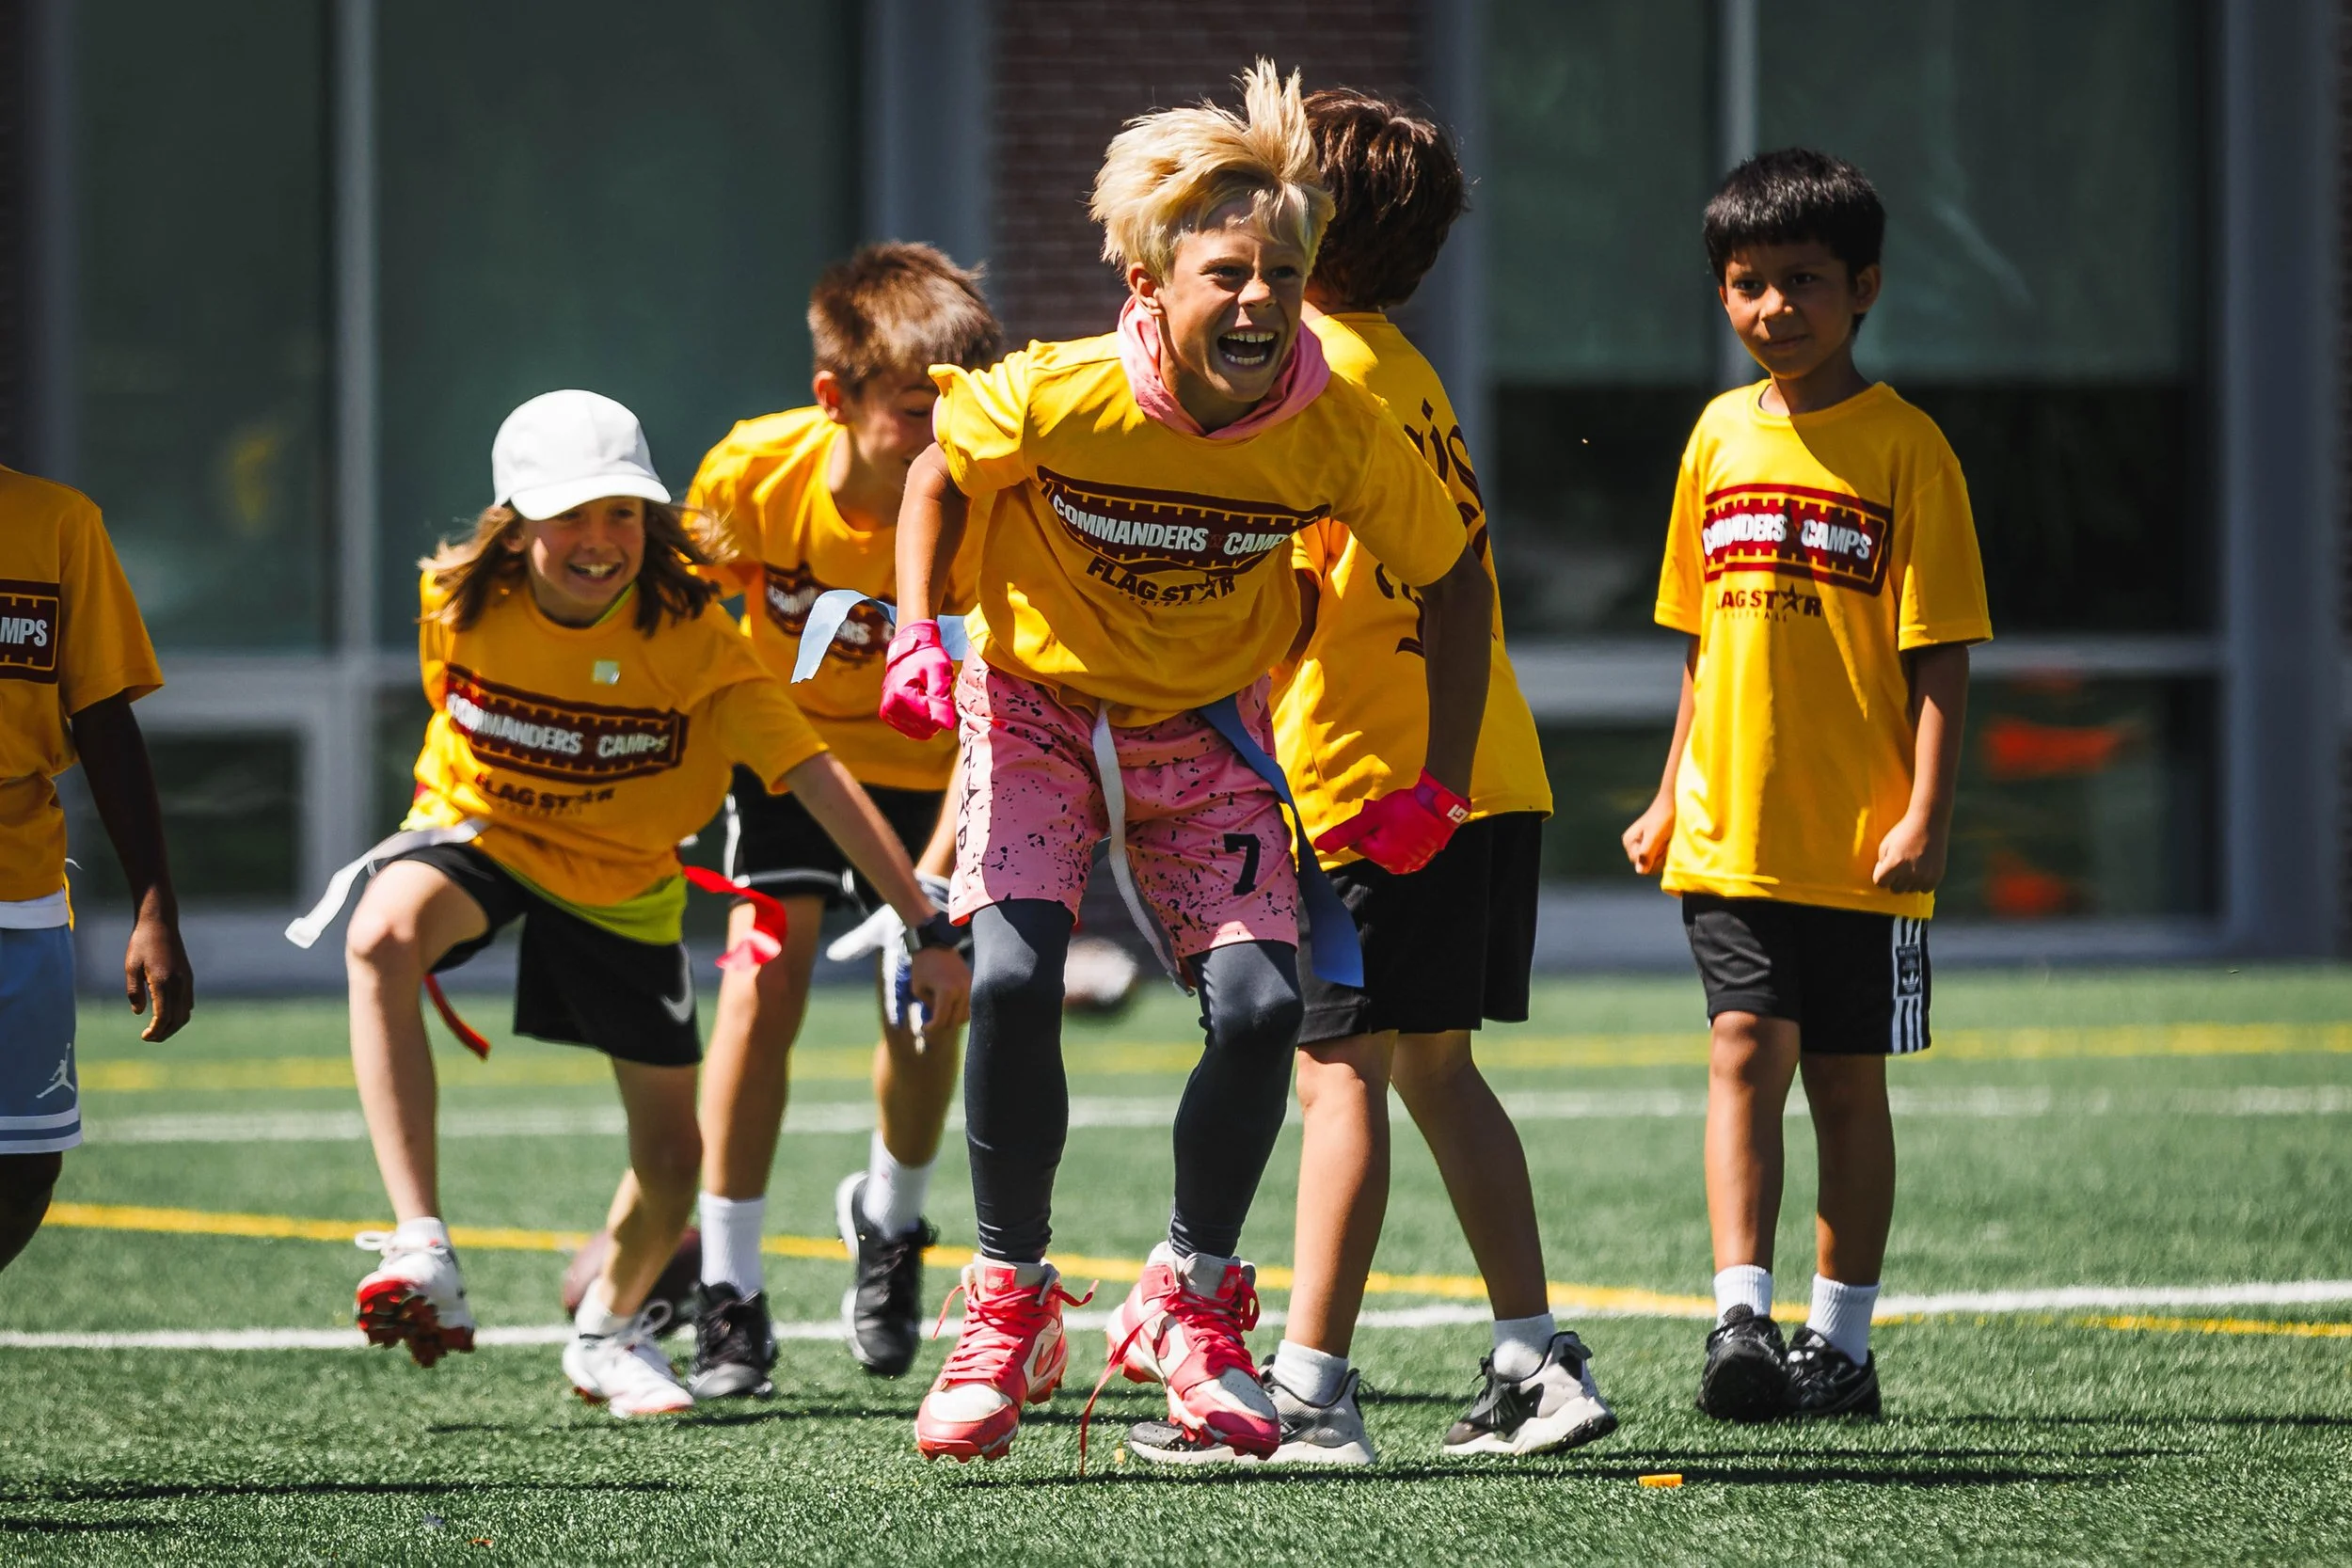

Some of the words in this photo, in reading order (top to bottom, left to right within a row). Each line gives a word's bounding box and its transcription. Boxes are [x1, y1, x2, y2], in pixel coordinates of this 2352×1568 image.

[1052, 494, 1209, 552] COMMANDERS
[1223, 531, 1289, 555] CAMP
[1801, 519, 1872, 560] CAMPS
[0, 616, 48, 647] MPS
[596, 732, 671, 757] CAMPS
[1223, 832, 1262, 896] 7
